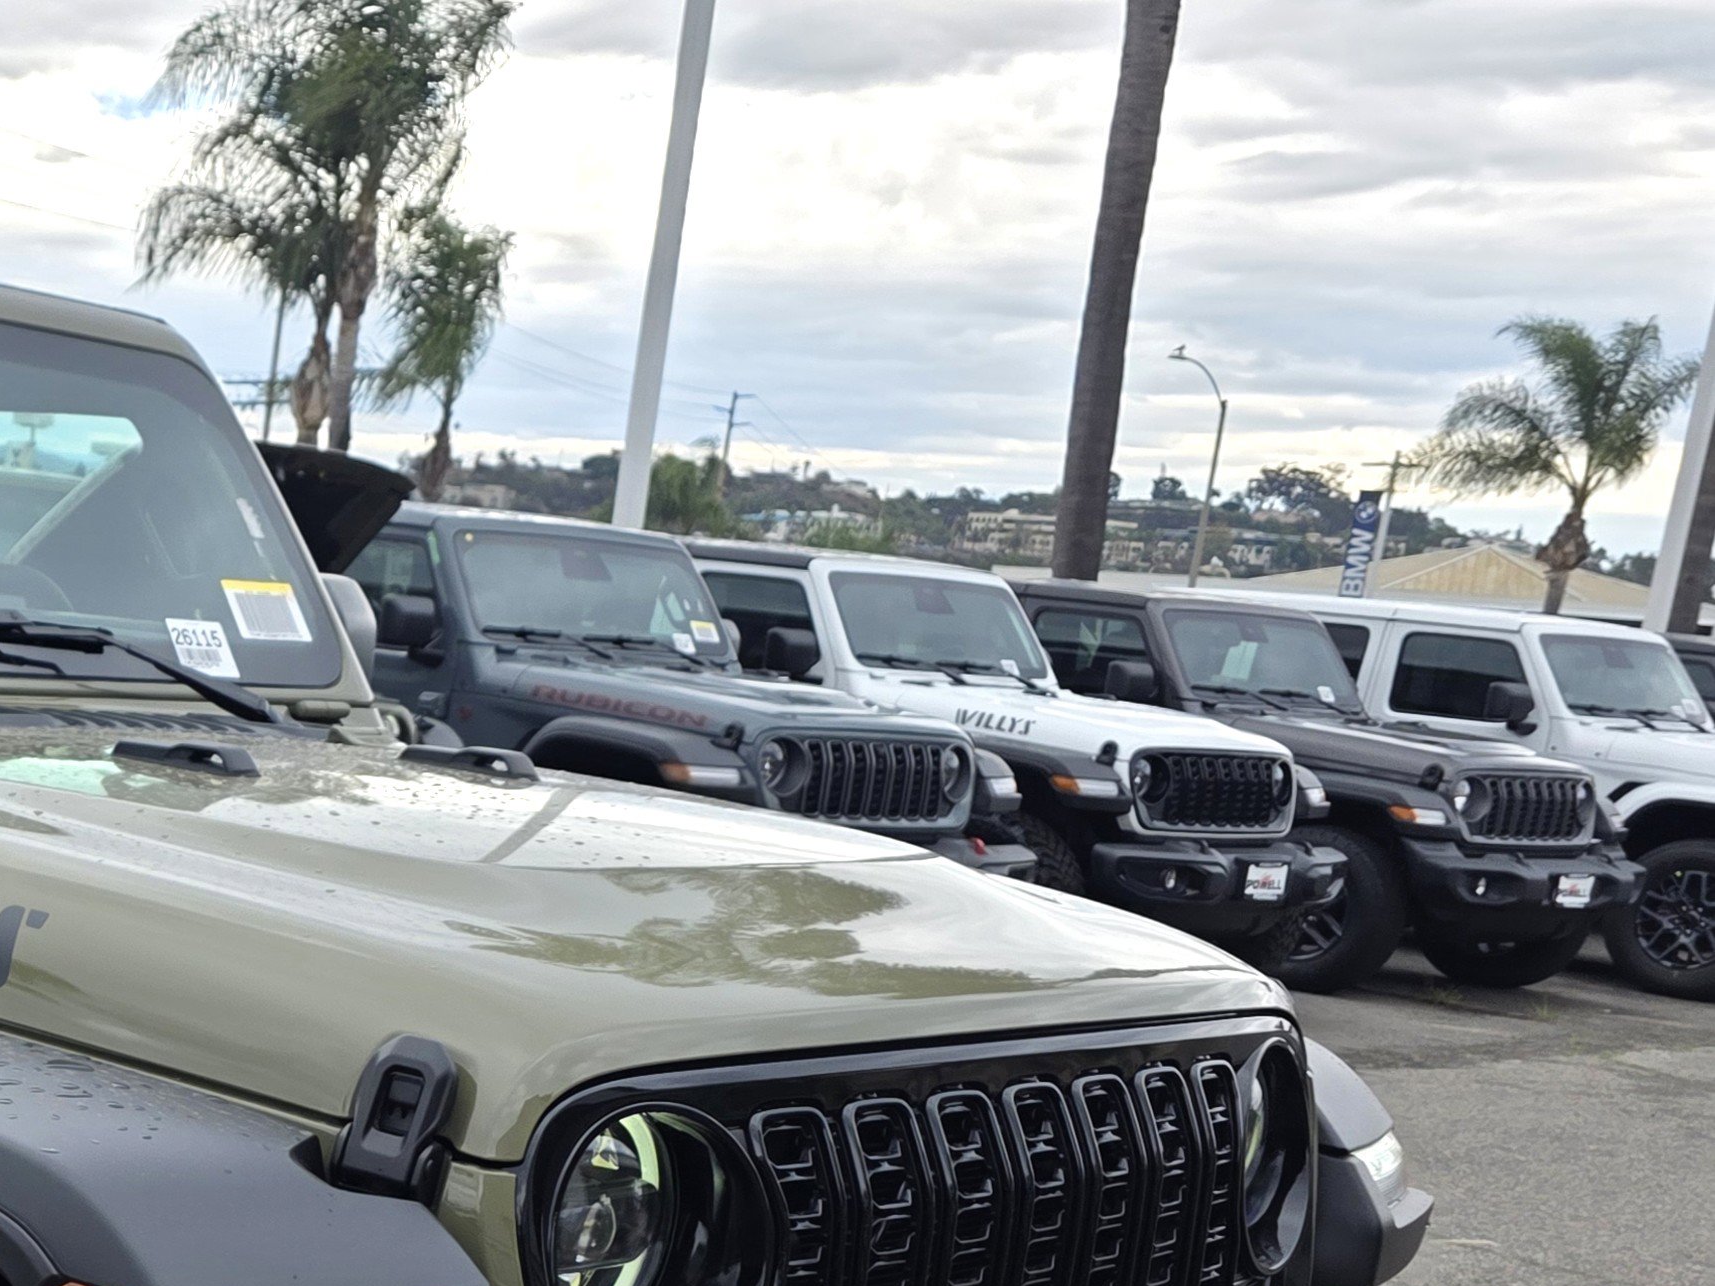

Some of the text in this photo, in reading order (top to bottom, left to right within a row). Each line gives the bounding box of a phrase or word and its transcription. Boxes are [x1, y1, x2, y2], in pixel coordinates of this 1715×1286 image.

[1340, 528, 1374, 596] BMW
[171, 627, 223, 648] 26115
[531, 684, 708, 728] RUBICON
[955, 708, 1036, 735] WILLYS
